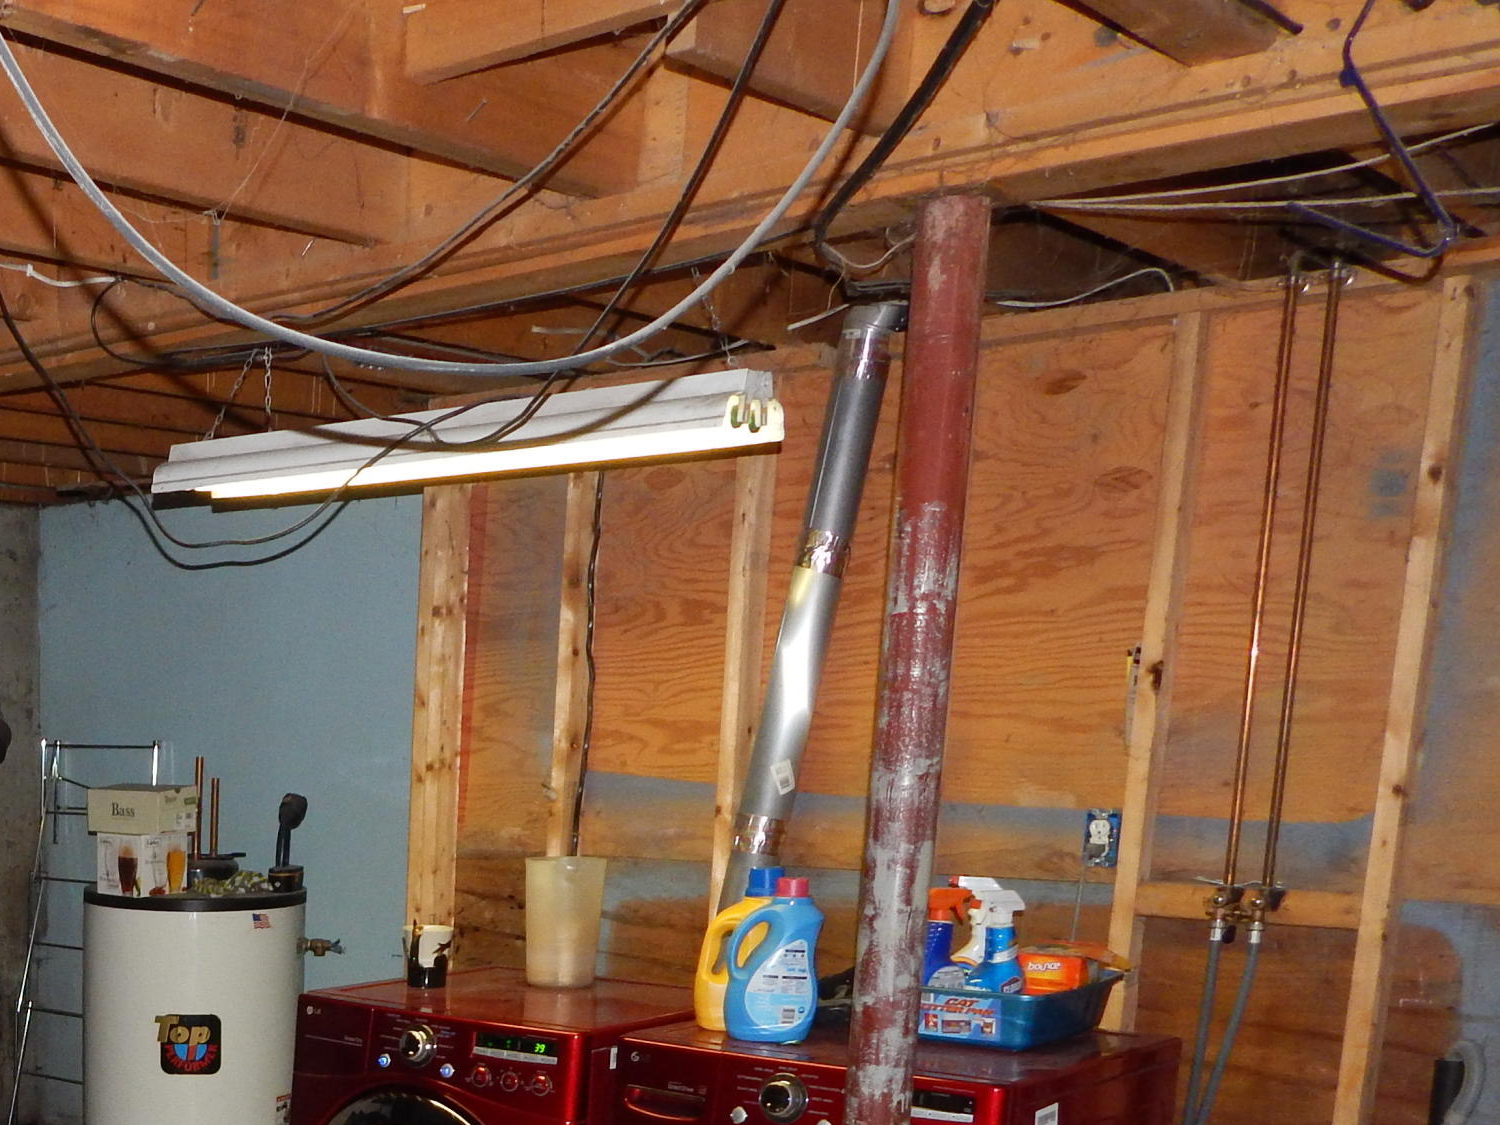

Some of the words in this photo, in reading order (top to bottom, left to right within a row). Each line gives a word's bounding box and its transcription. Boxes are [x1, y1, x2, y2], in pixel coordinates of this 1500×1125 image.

[111, 802, 135, 817] Bass
[1027, 961, 1061, 972] bounce
[155, 1015, 211, 1046] Top
[534, 1043, 546, 1053] 39
